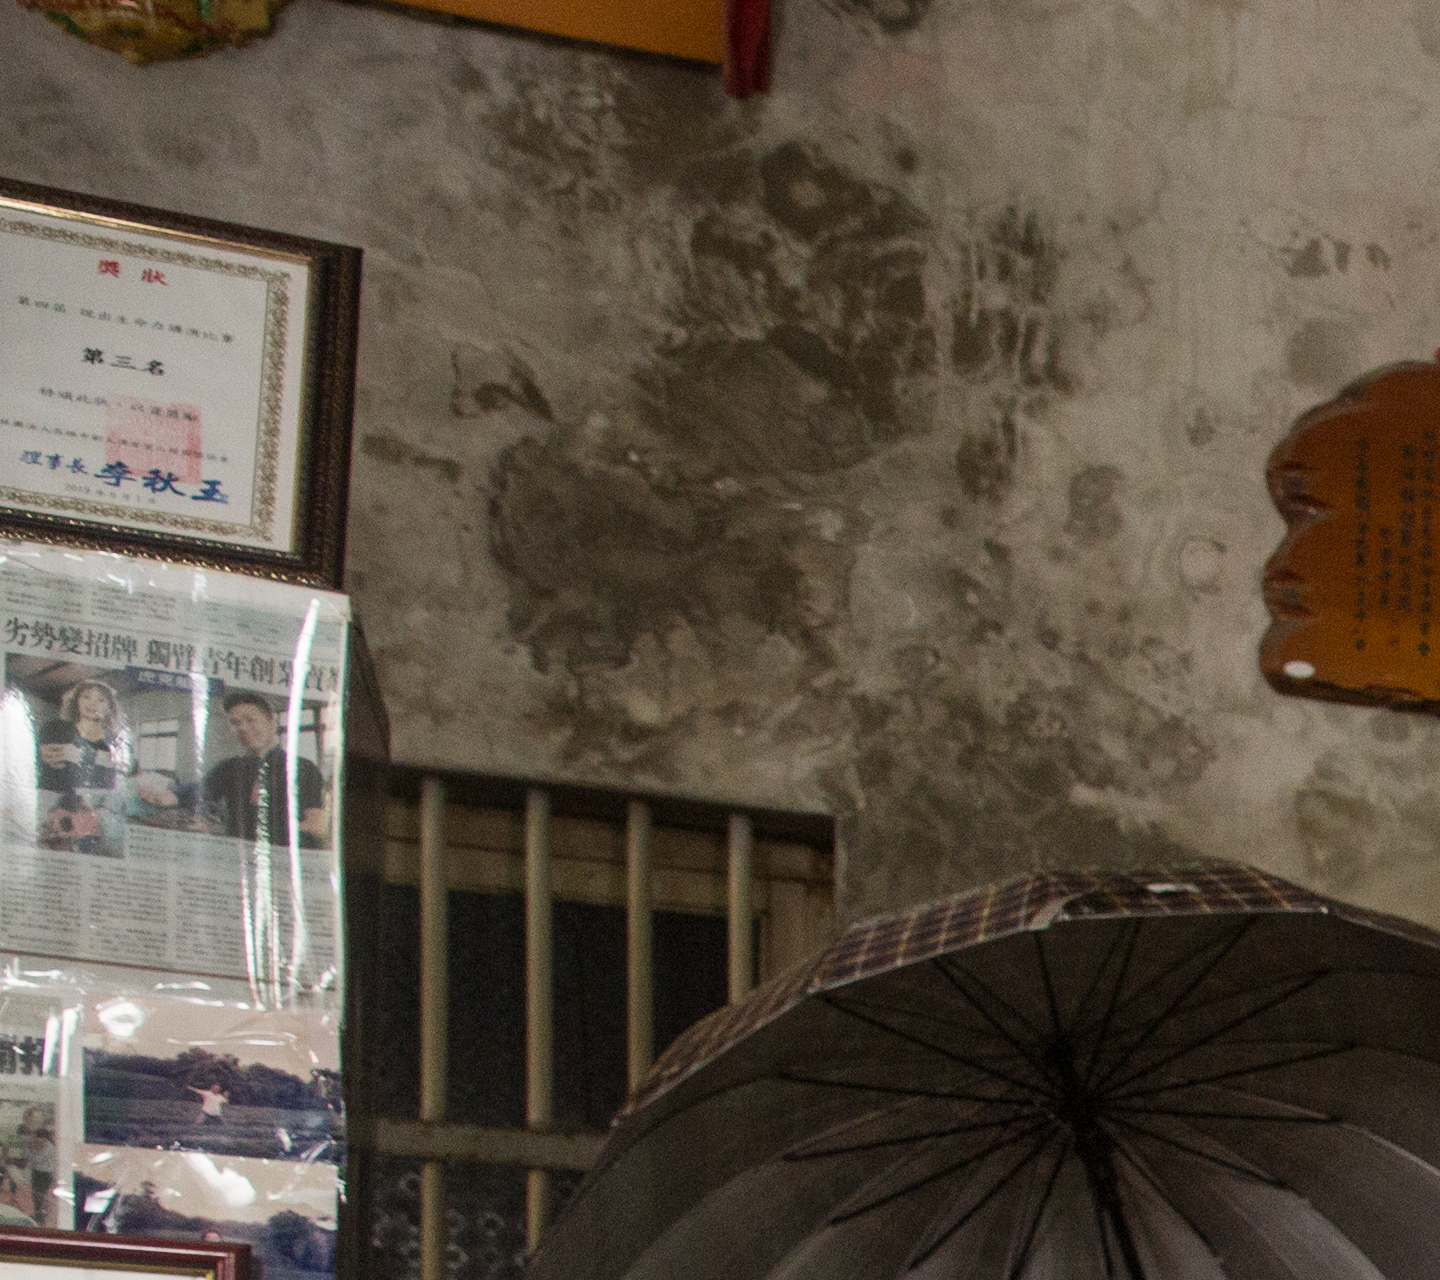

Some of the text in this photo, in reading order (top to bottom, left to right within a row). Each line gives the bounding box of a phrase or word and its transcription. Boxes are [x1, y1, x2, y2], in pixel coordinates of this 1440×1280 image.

[81, 347, 165, 376] 第三名
[20, 450, 88, 474] 理事長
